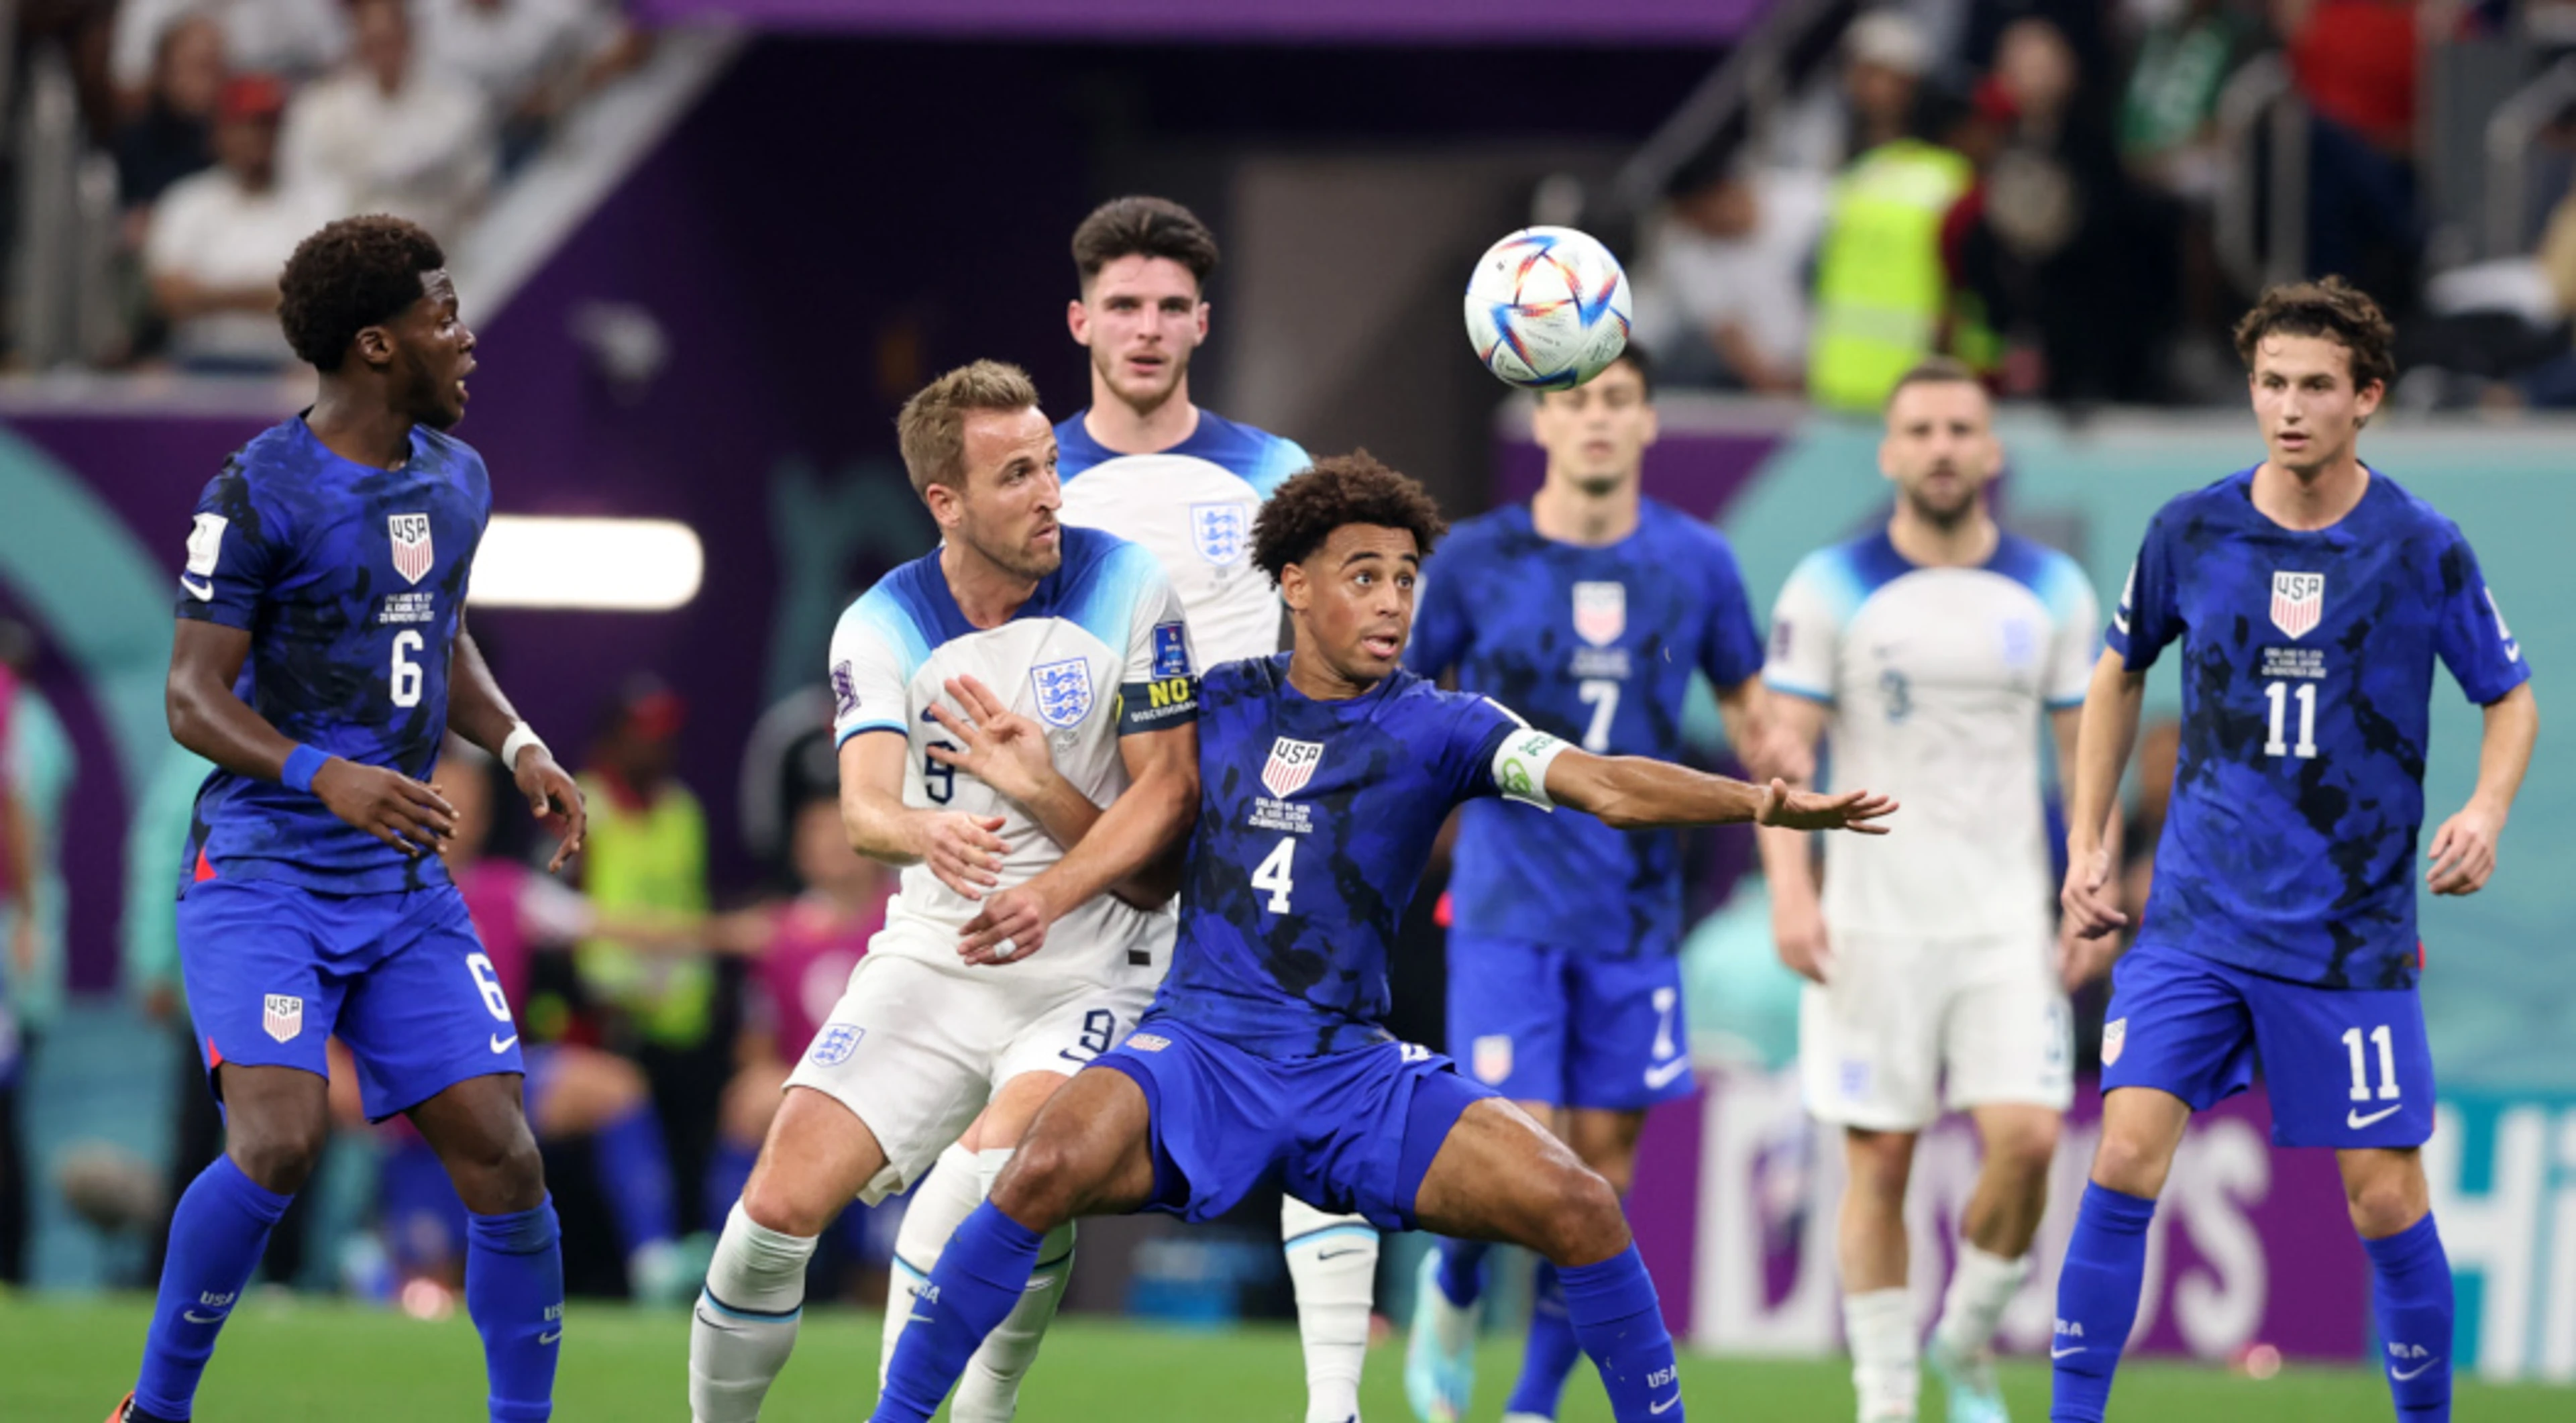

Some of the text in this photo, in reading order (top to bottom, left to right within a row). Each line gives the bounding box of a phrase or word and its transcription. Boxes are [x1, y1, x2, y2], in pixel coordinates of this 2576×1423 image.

[392, 517, 427, 543] USA
[2276, 576, 2319, 601] USA
[390, 630, 423, 708] 6
[1148, 678, 1189, 708] NO
[1579, 679, 1620, 753] 7
[2264, 681, 2317, 758] 11
[925, 740, 957, 805] 9
[1275, 740, 1319, 764] USA
[1250, 837, 1297, 914] 4
[266, 998, 301, 1017] USA
[466, 952, 512, 1022] 6
[1079, 1008, 1117, 1055] 9
[2343, 1025, 2401, 1101] 11
